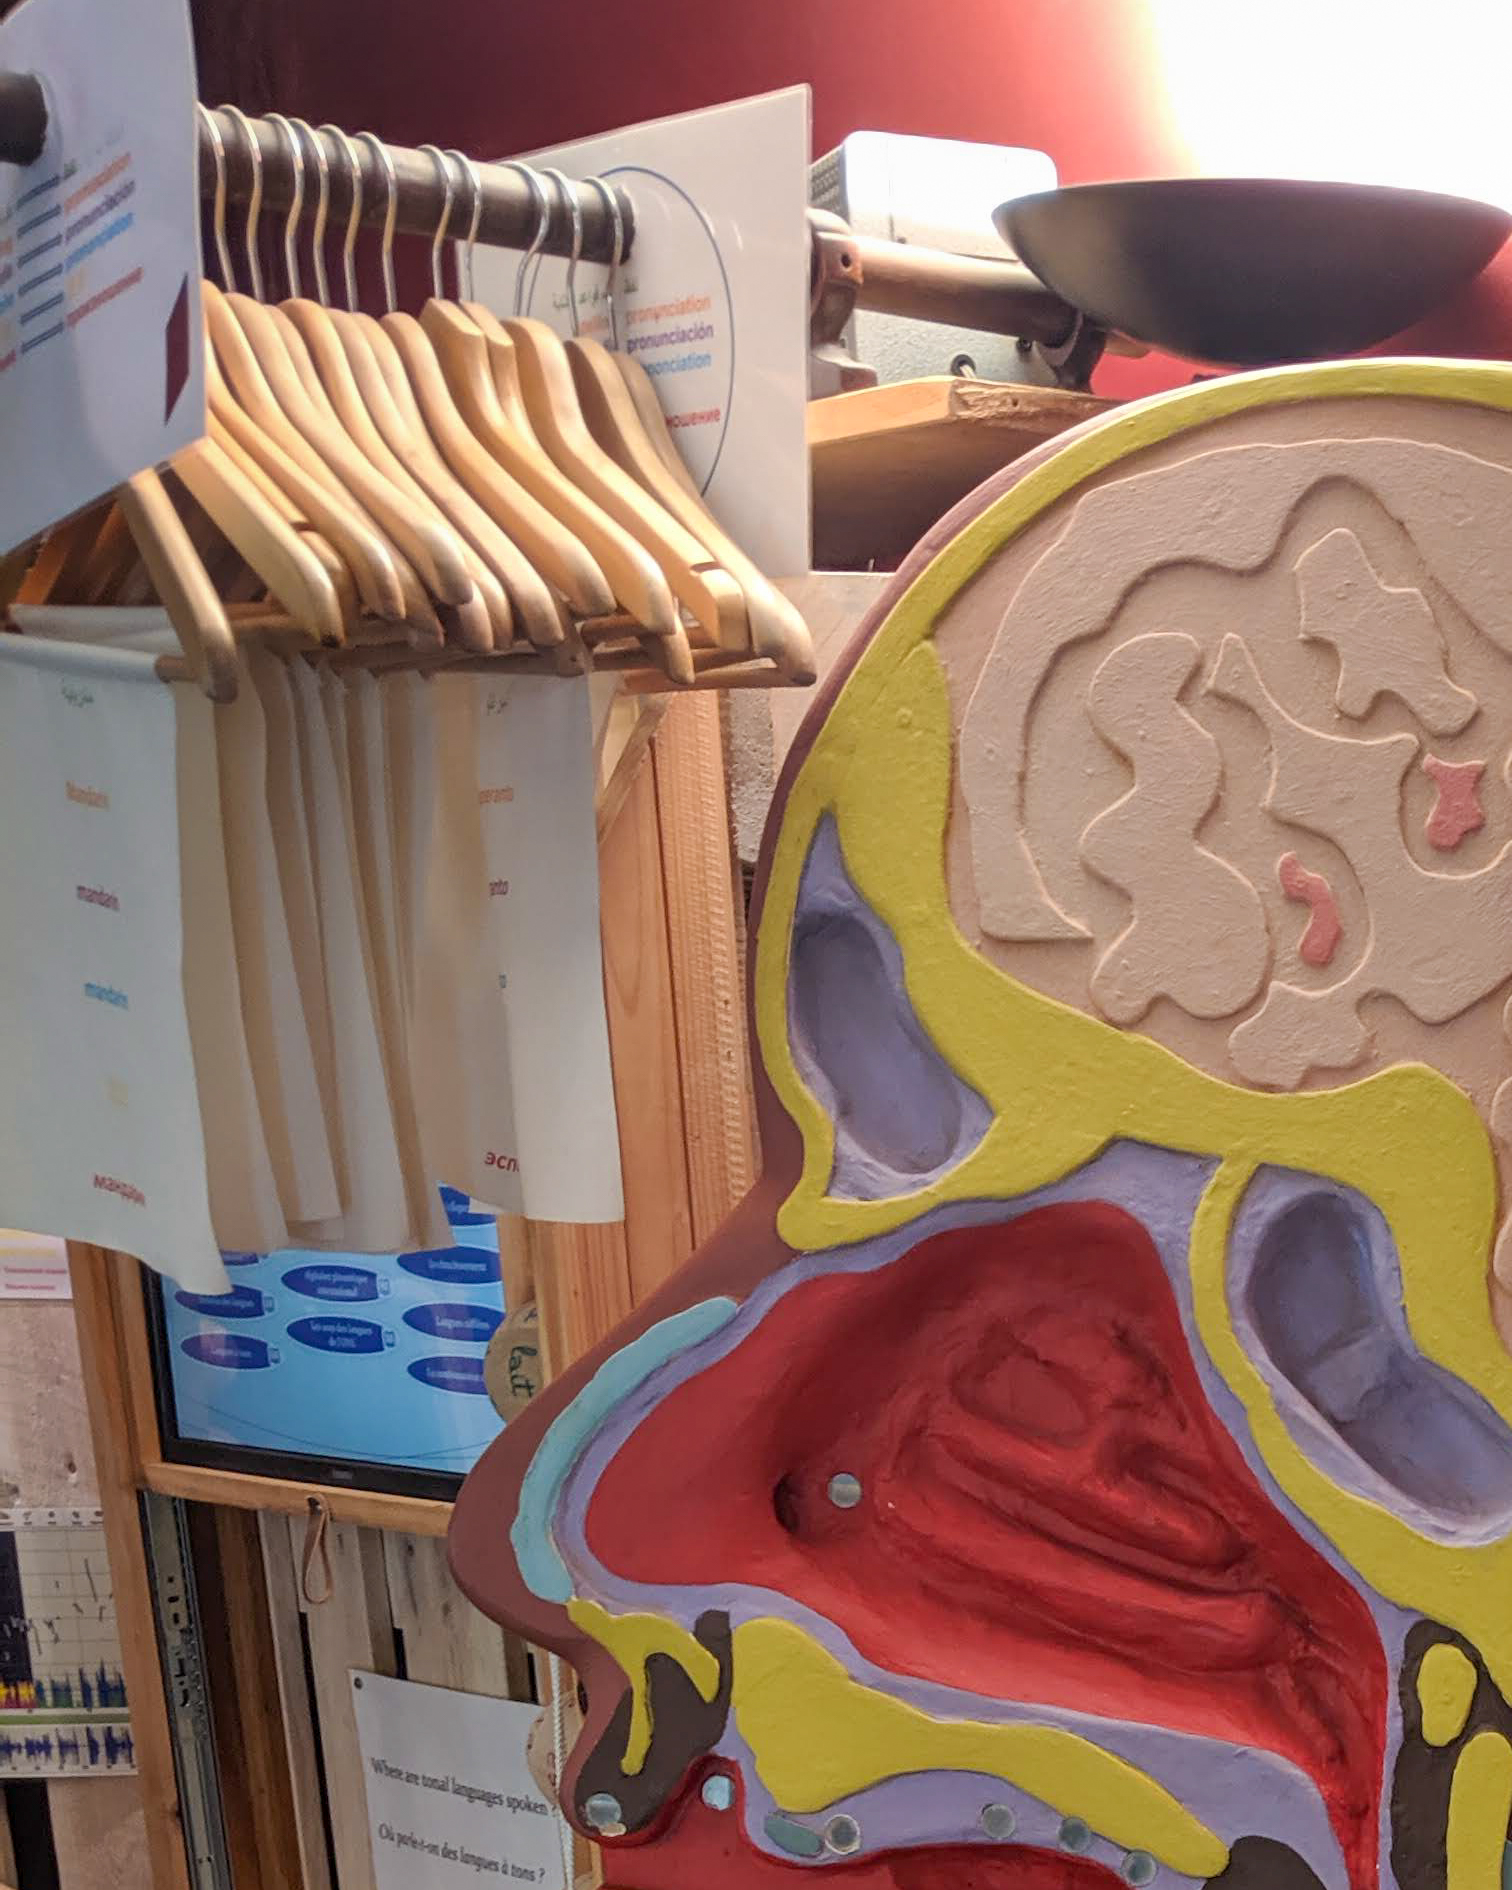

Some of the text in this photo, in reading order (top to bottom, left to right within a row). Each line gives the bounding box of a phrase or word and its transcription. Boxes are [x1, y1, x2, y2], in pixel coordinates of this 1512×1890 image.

[371, 1757, 548, 1816] Where are tonal languages spoken
[397, 1831, 440, 1856] parle-t-on
[441, 1842, 458, 1861] des
[460, 1846, 499, 1872] langues
[511, 1863, 535, 1882] tons
